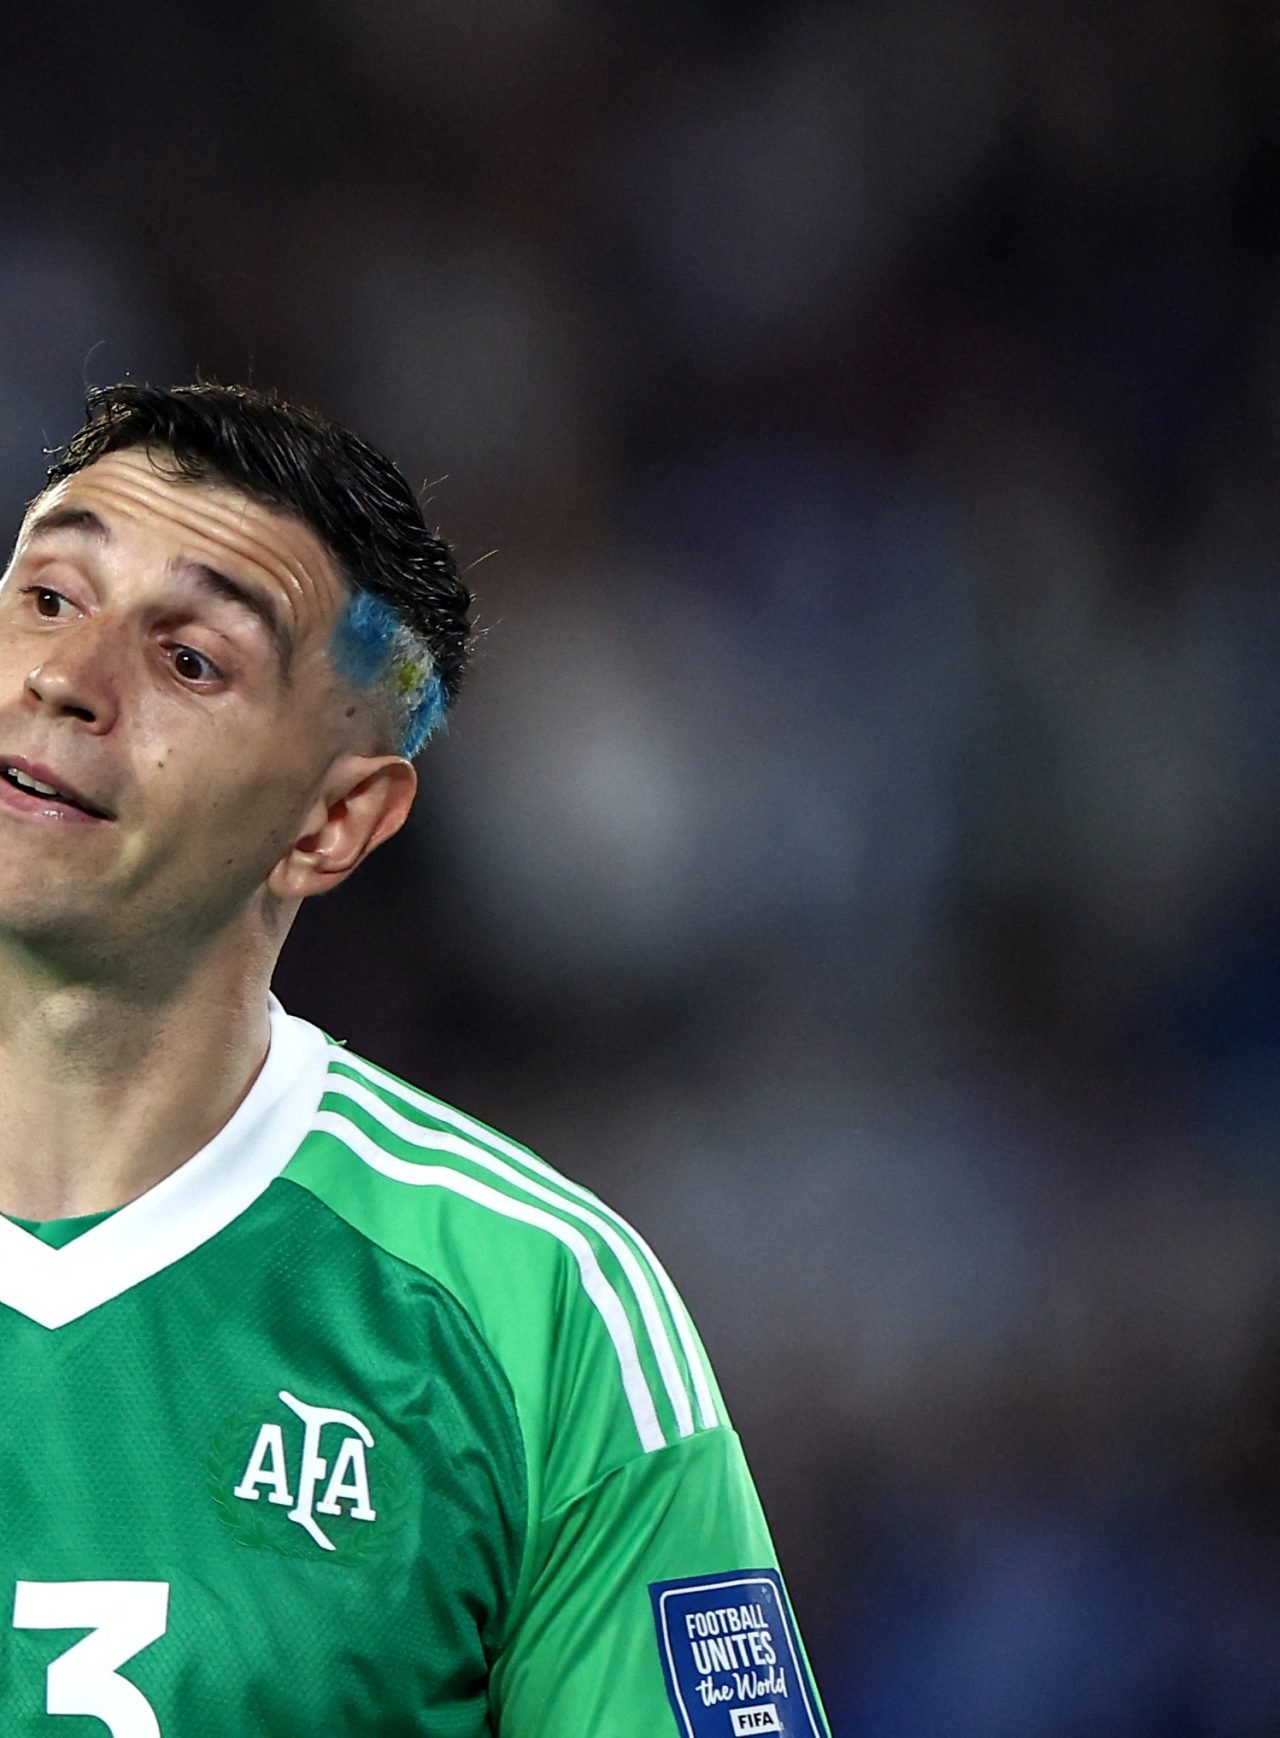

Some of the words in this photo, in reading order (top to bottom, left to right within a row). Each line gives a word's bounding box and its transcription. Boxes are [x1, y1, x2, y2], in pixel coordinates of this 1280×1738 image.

[233, 1390, 375, 1551] AFA
[685, 1604, 769, 1639] FOOTBALL
[690, 1631, 777, 1675] UNITES
[695, 1676, 734, 1707] the
[732, 1667, 789, 1701] World
[737, 1711, 775, 1729] FIFA
